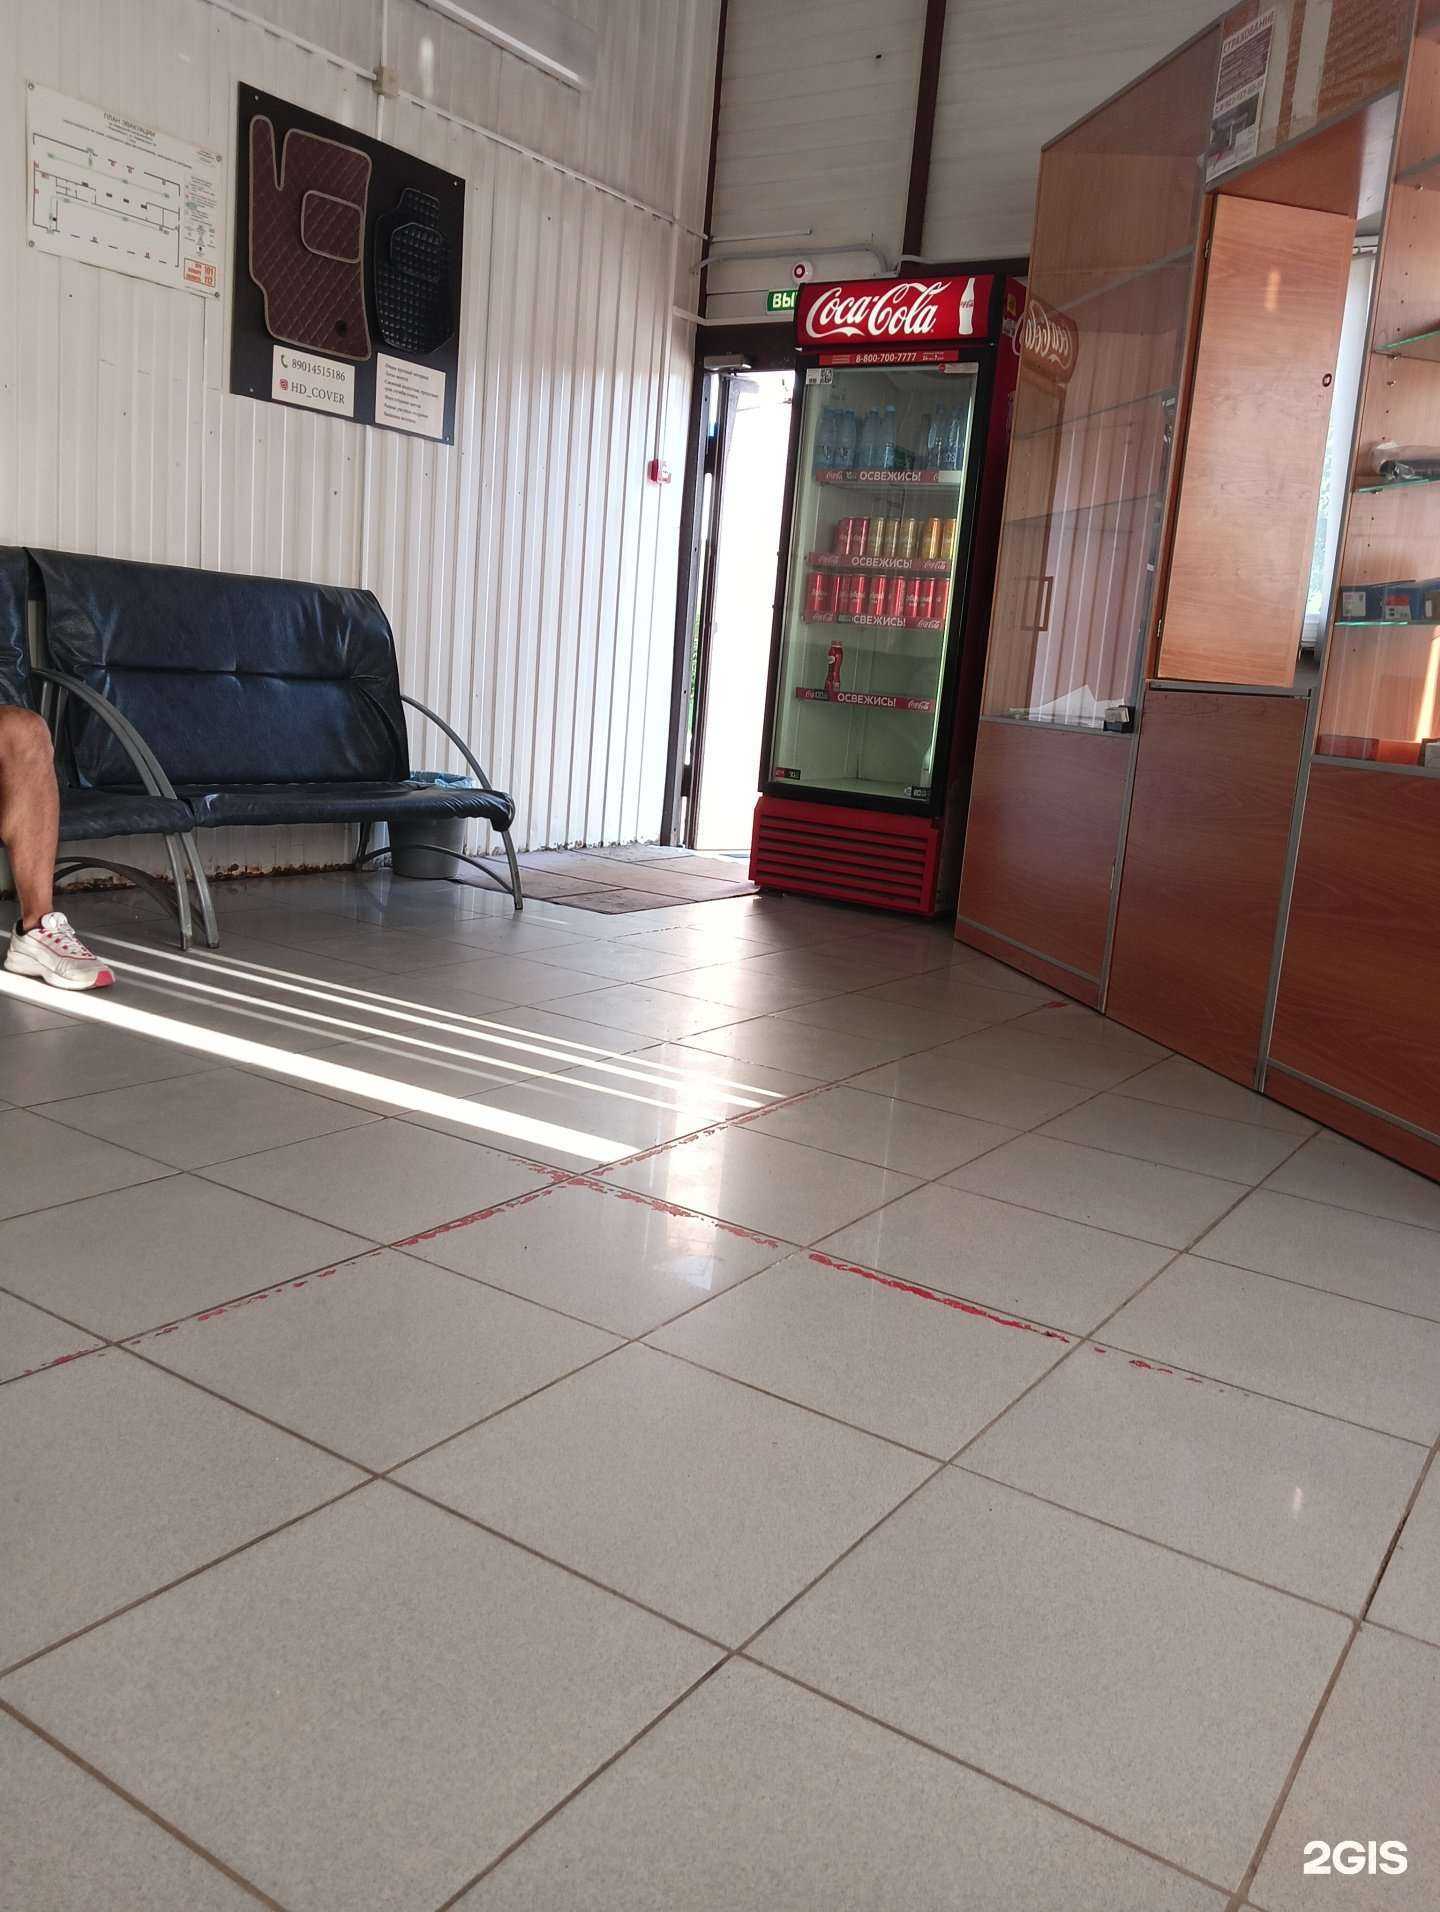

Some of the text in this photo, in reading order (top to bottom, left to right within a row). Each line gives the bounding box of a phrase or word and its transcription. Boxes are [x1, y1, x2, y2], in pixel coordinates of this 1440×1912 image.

[773, 291, 798, 308] ВЫ
[806, 281, 952, 338] Coca-Cola
[855, 352, 917, 364] 8-800-700-7777
[291, 358, 346, 382] 89014515186
[291, 381, 345, 404] HD_COVER
[859, 471, 921, 482] ОСВЕЖИСЬ!
[851, 556, 912, 569] ОСВЕЖИСЬ!
[851, 614, 906, 627] СВЕЖИСЬ!
[837, 692, 897, 707] ОСВЕЖИСЬ!
